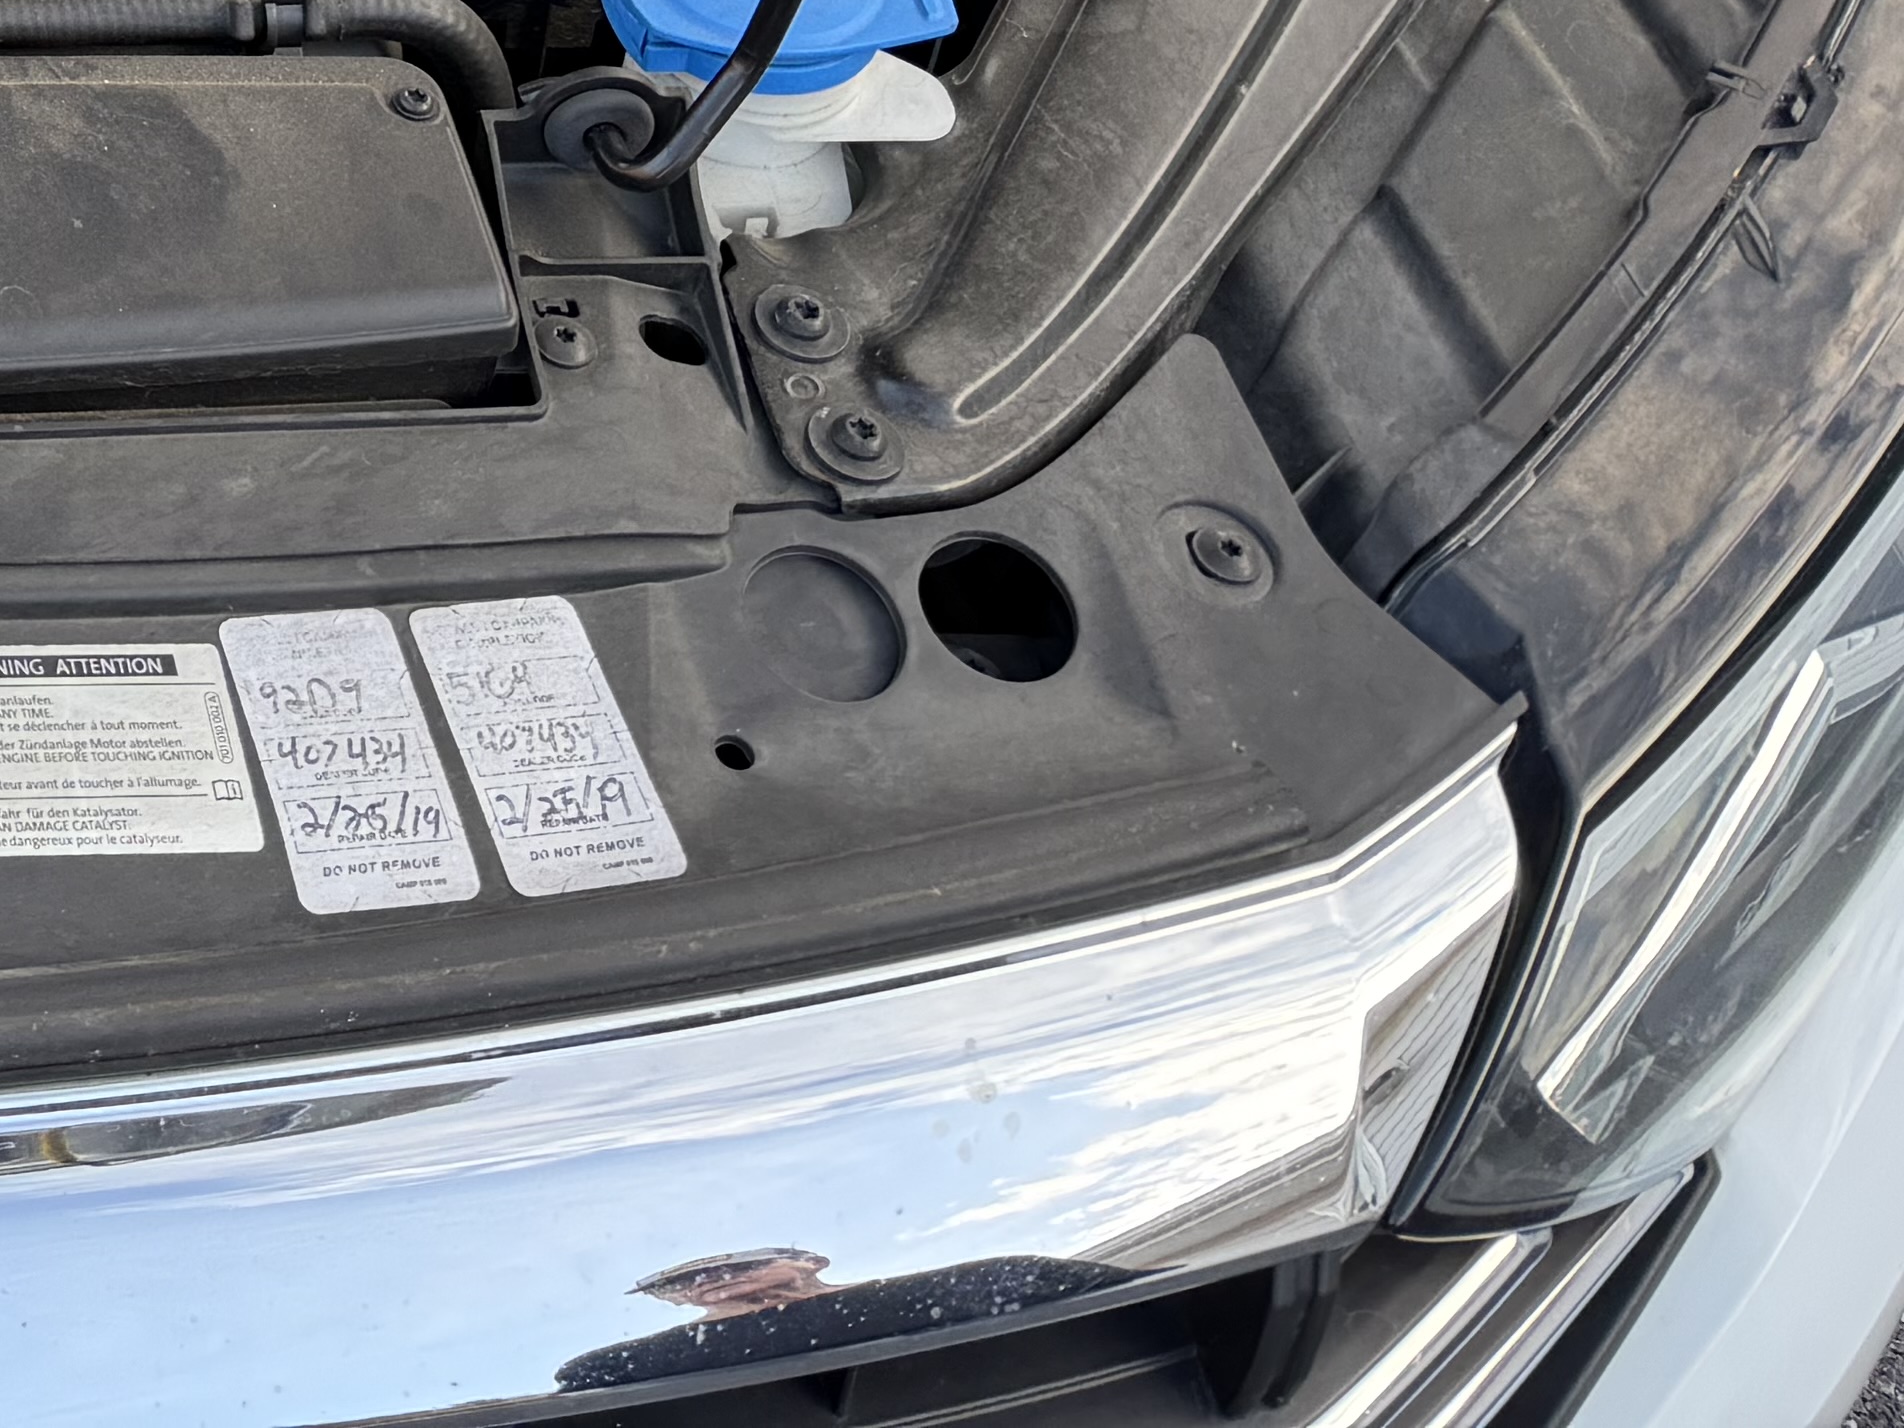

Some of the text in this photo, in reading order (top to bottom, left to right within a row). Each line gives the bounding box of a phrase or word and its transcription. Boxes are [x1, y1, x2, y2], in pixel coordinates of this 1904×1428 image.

[55, 657, 163, 675] ATTENTION
[21, 708, 54, 719] TIME.
[44, 751, 89, 763] BEFORE
[91, 750, 155, 763] TOUCHING
[157, 750, 214, 762] IGNITION
[15, 820, 70, 832] DAMAGE
[72, 819, 131, 831] CATALYST.
[529, 836, 646, 862] DO NOT REMOVE
[322, 856, 442, 878] DO NOT REMOVE
